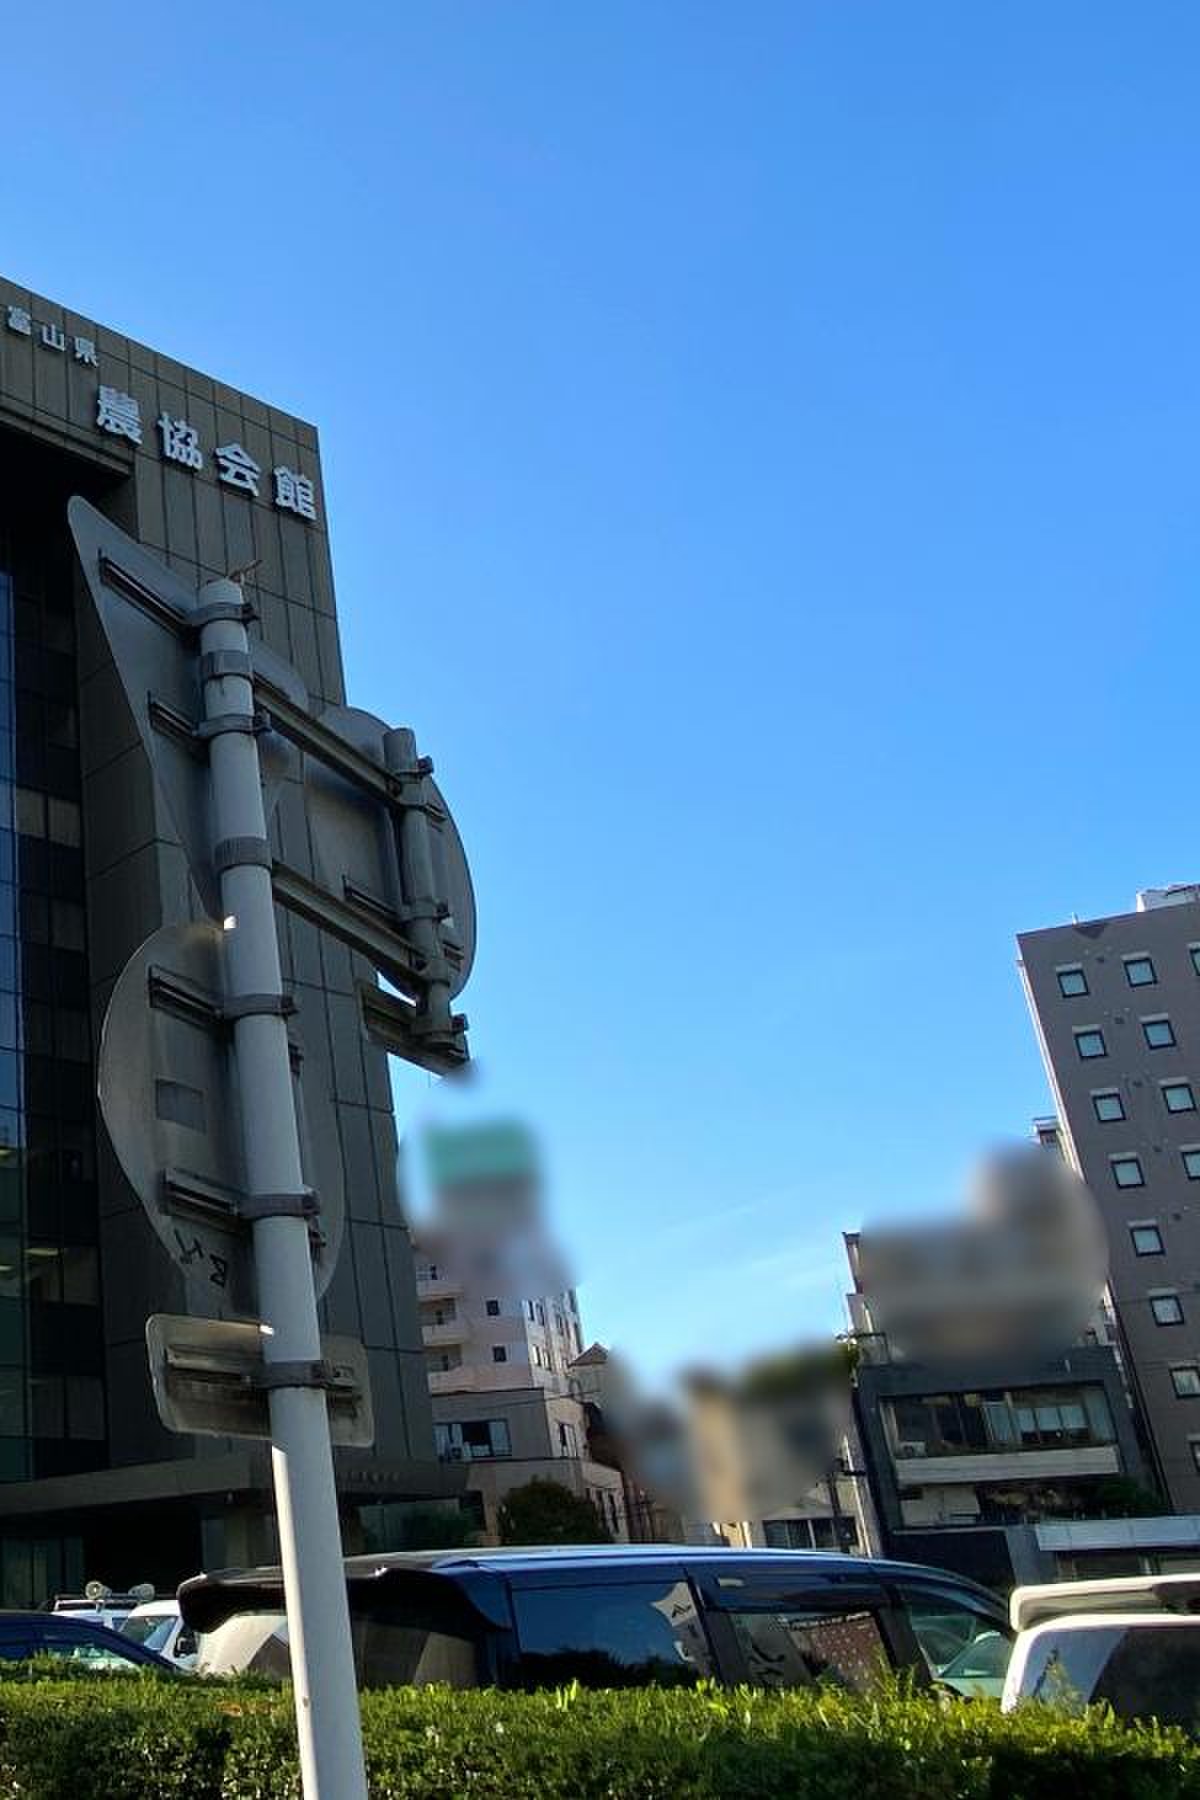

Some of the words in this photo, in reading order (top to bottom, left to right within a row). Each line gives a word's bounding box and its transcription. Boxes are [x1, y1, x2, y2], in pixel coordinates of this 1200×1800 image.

[6, 304, 98, 367] 富山県
[96, 384, 316, 521] 農協会館
